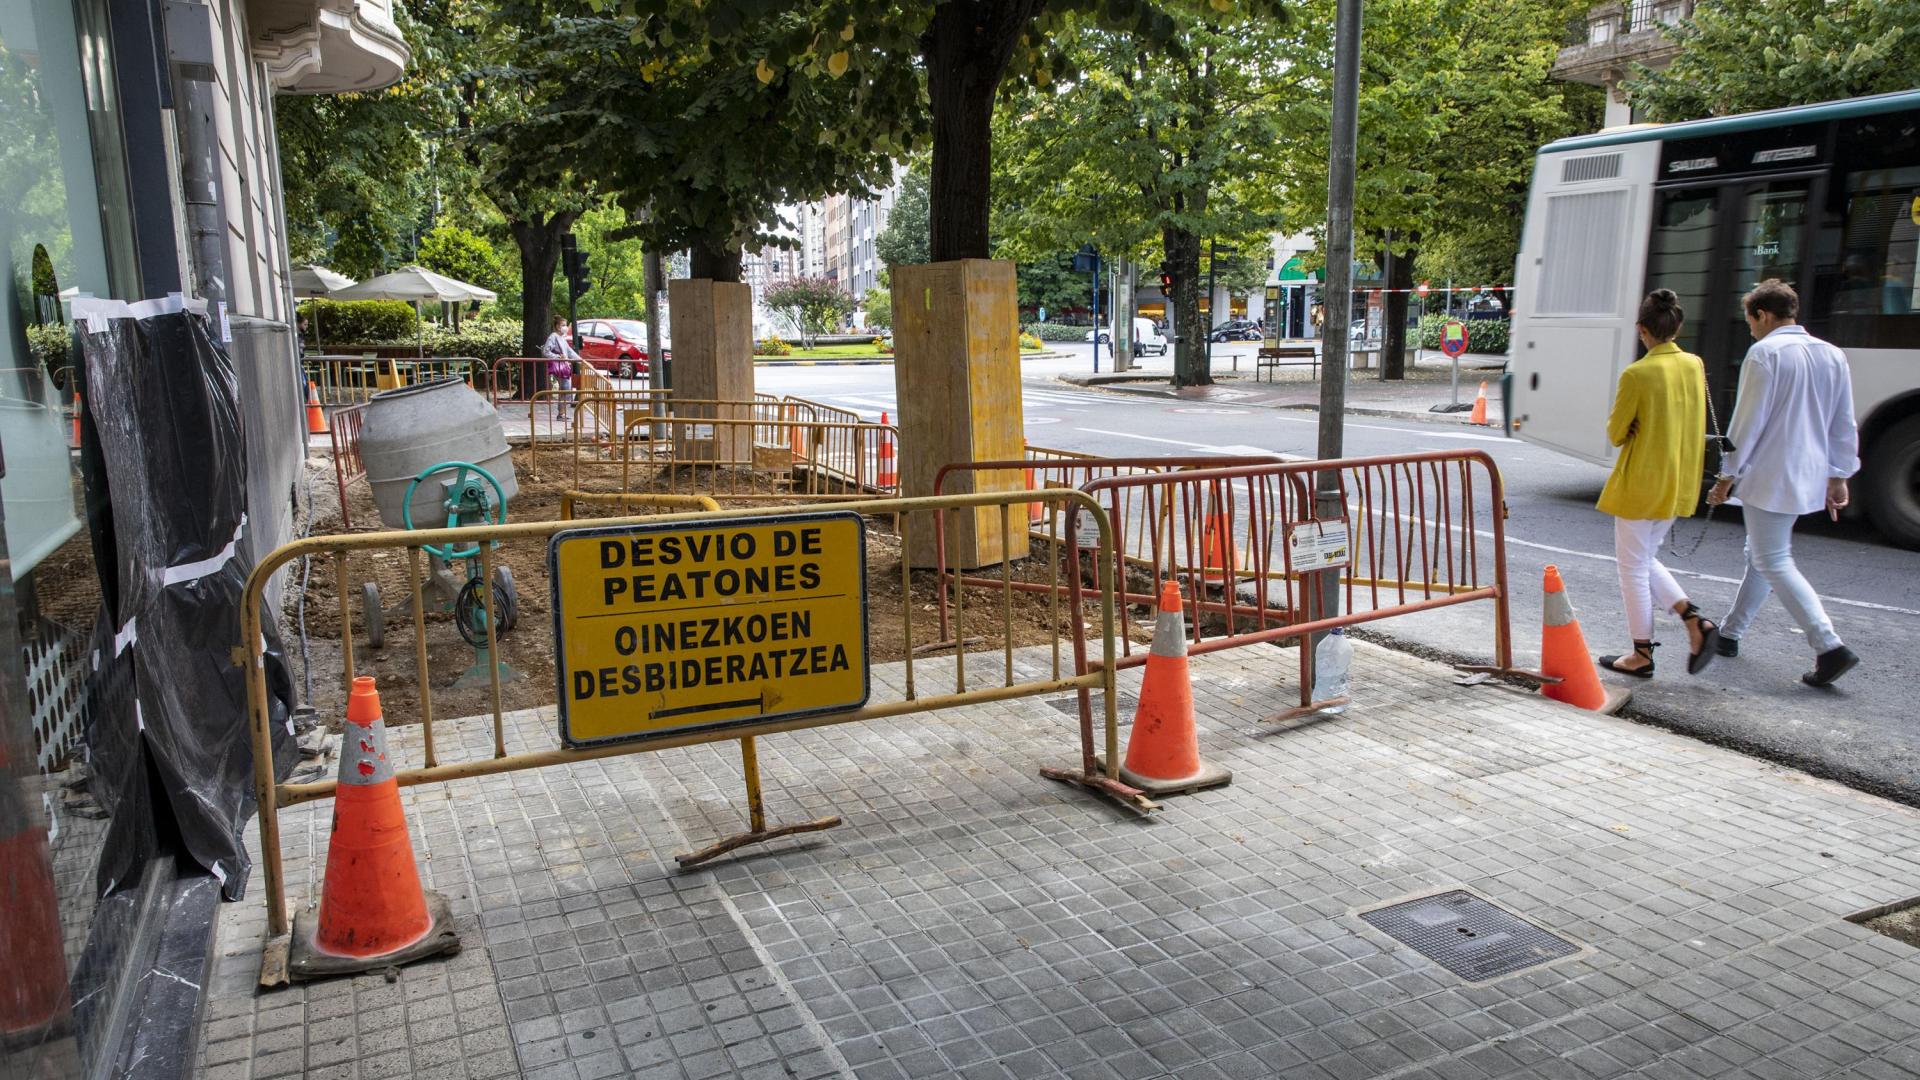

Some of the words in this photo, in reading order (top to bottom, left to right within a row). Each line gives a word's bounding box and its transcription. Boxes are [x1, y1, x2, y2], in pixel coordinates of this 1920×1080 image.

[600, 534, 757, 569] DESVIO
[773, 528, 822, 558] DE
[603, 562, 821, 606] PEATONES
[614, 610, 811, 657] OINEZKOEN
[574, 643, 850, 701] DESBIDERATZEA
